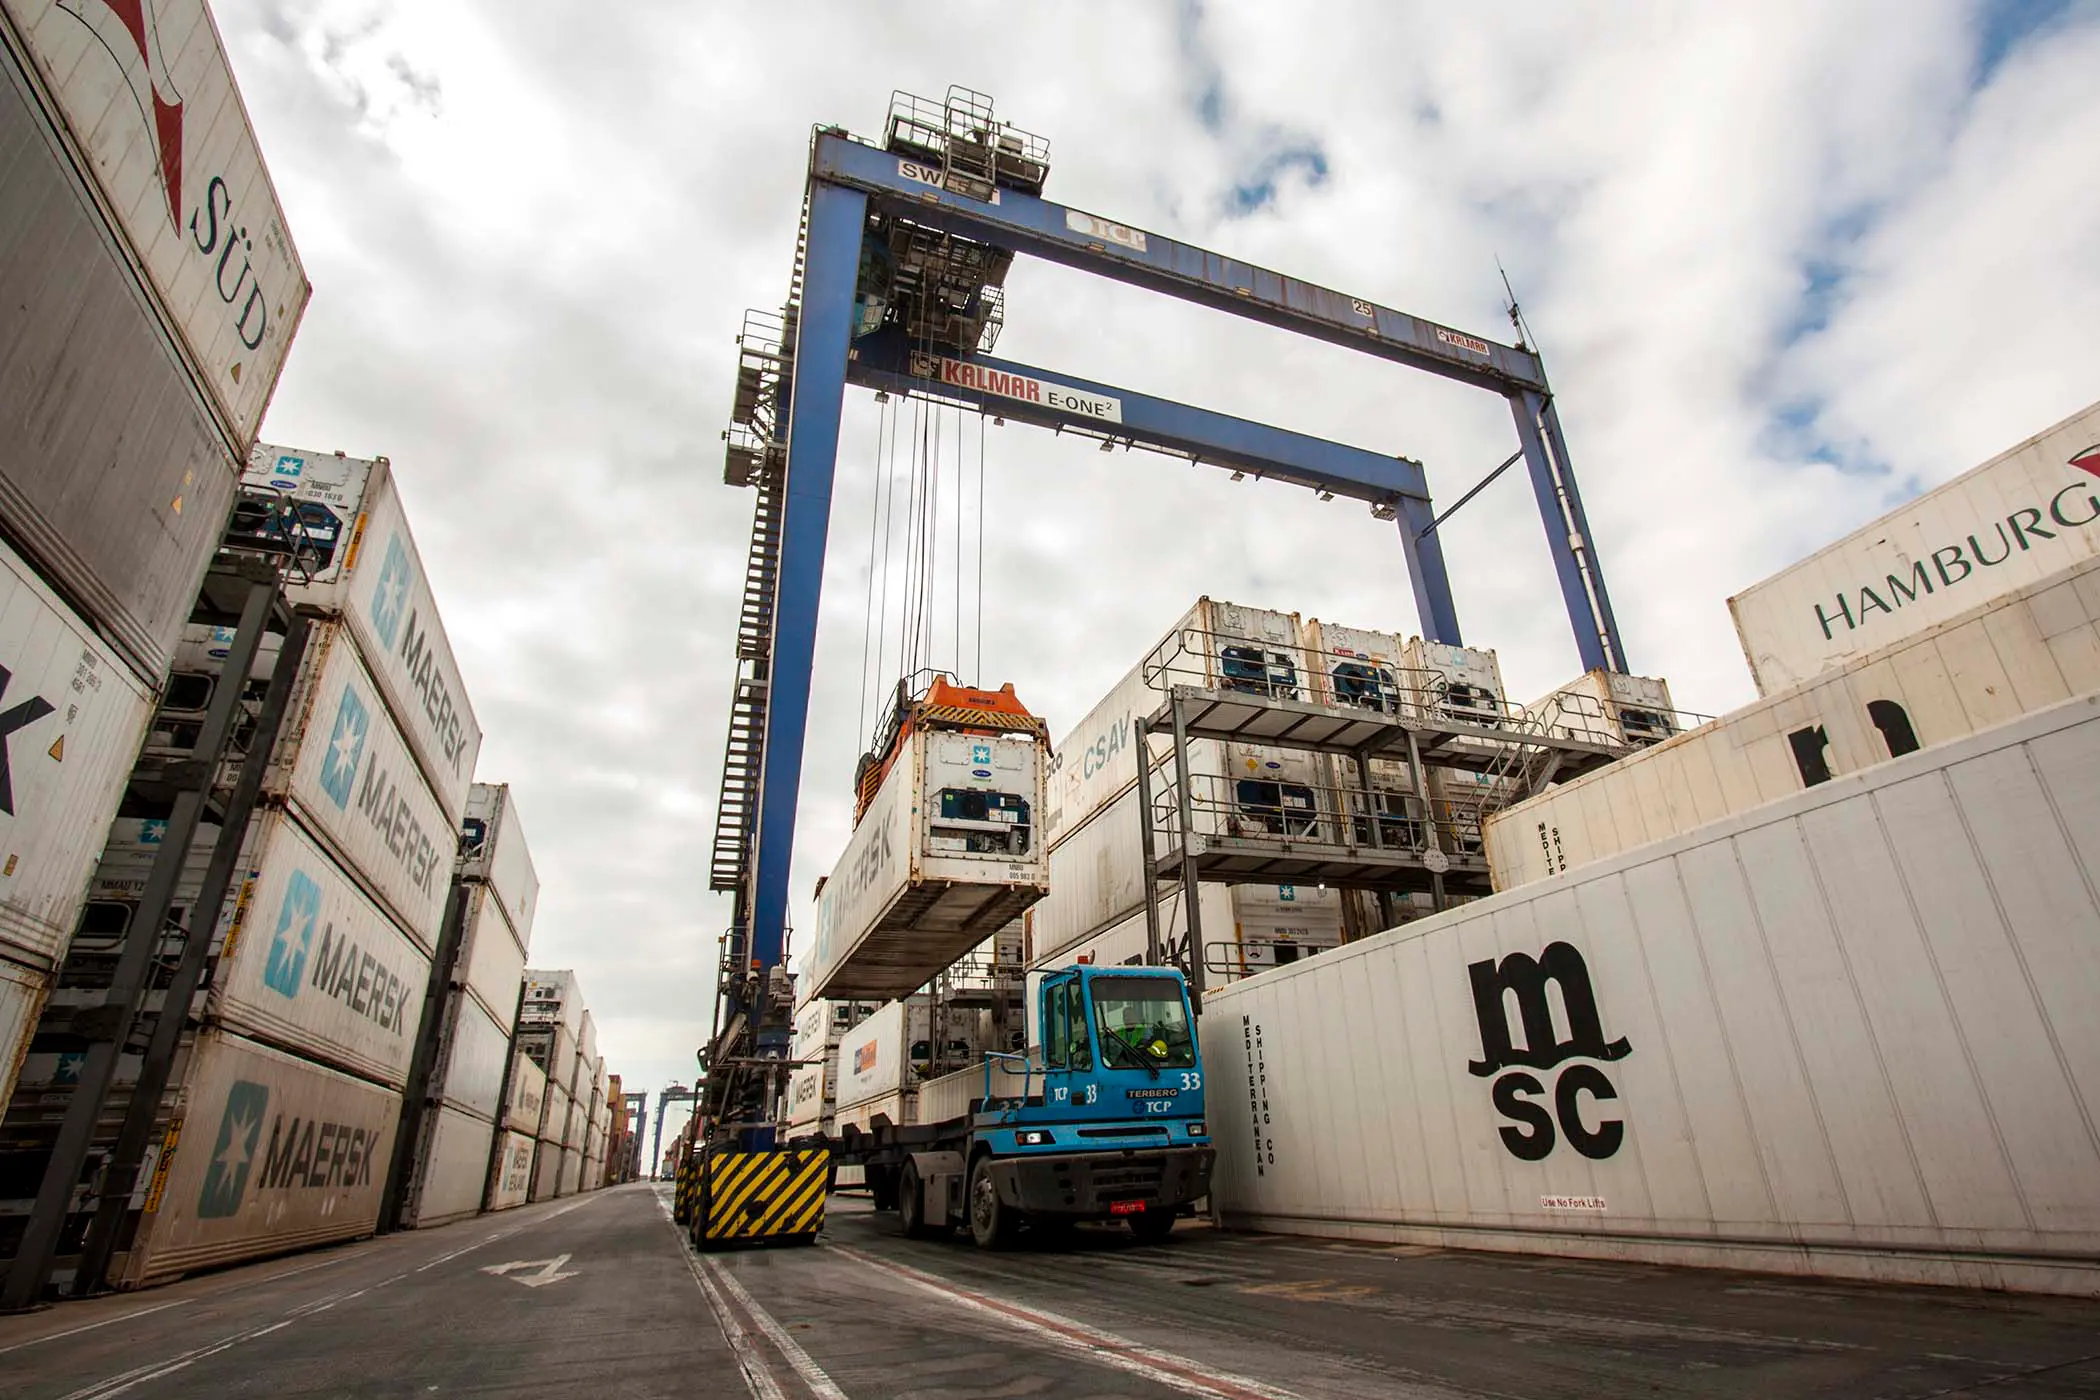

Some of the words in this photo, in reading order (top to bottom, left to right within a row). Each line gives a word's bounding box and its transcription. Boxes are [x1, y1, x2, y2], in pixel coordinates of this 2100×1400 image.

[190, 176, 266, 350] SÜD
[1353, 300, 1372, 316] 25
[1450, 333, 1488, 353] KALMAR
[944, 360, 1040, 402] KALMAR
[1814, 482, 2100, 640] HAMBURG
[401, 607, 467, 781] MAERSK
[1084, 710, 1130, 780] CSAV
[358, 751, 440, 900] MAERSK
[312, 921, 411, 1037] MAERSK
[1054, 1087, 1068, 1101] TCP
[1086, 1084, 1097, 1104] 33
[1129, 1089, 1178, 1098] TERBERG
[1145, 1101, 1172, 1113] TCP
[1180, 1072, 1201, 1091] 33
[1243, 1015, 1264, 1177] MEDITERRANEAN
[1255, 1025, 1270, 1124] SHIPPING
[259, 1114, 379, 1189] MAERSK
[1542, 1198, 1556, 1207] Use
[1557, 1199, 1567, 1207] No
[1568, 1198, 1586, 1208] Fork
[1587, 1198, 1606, 1209] Lifts
